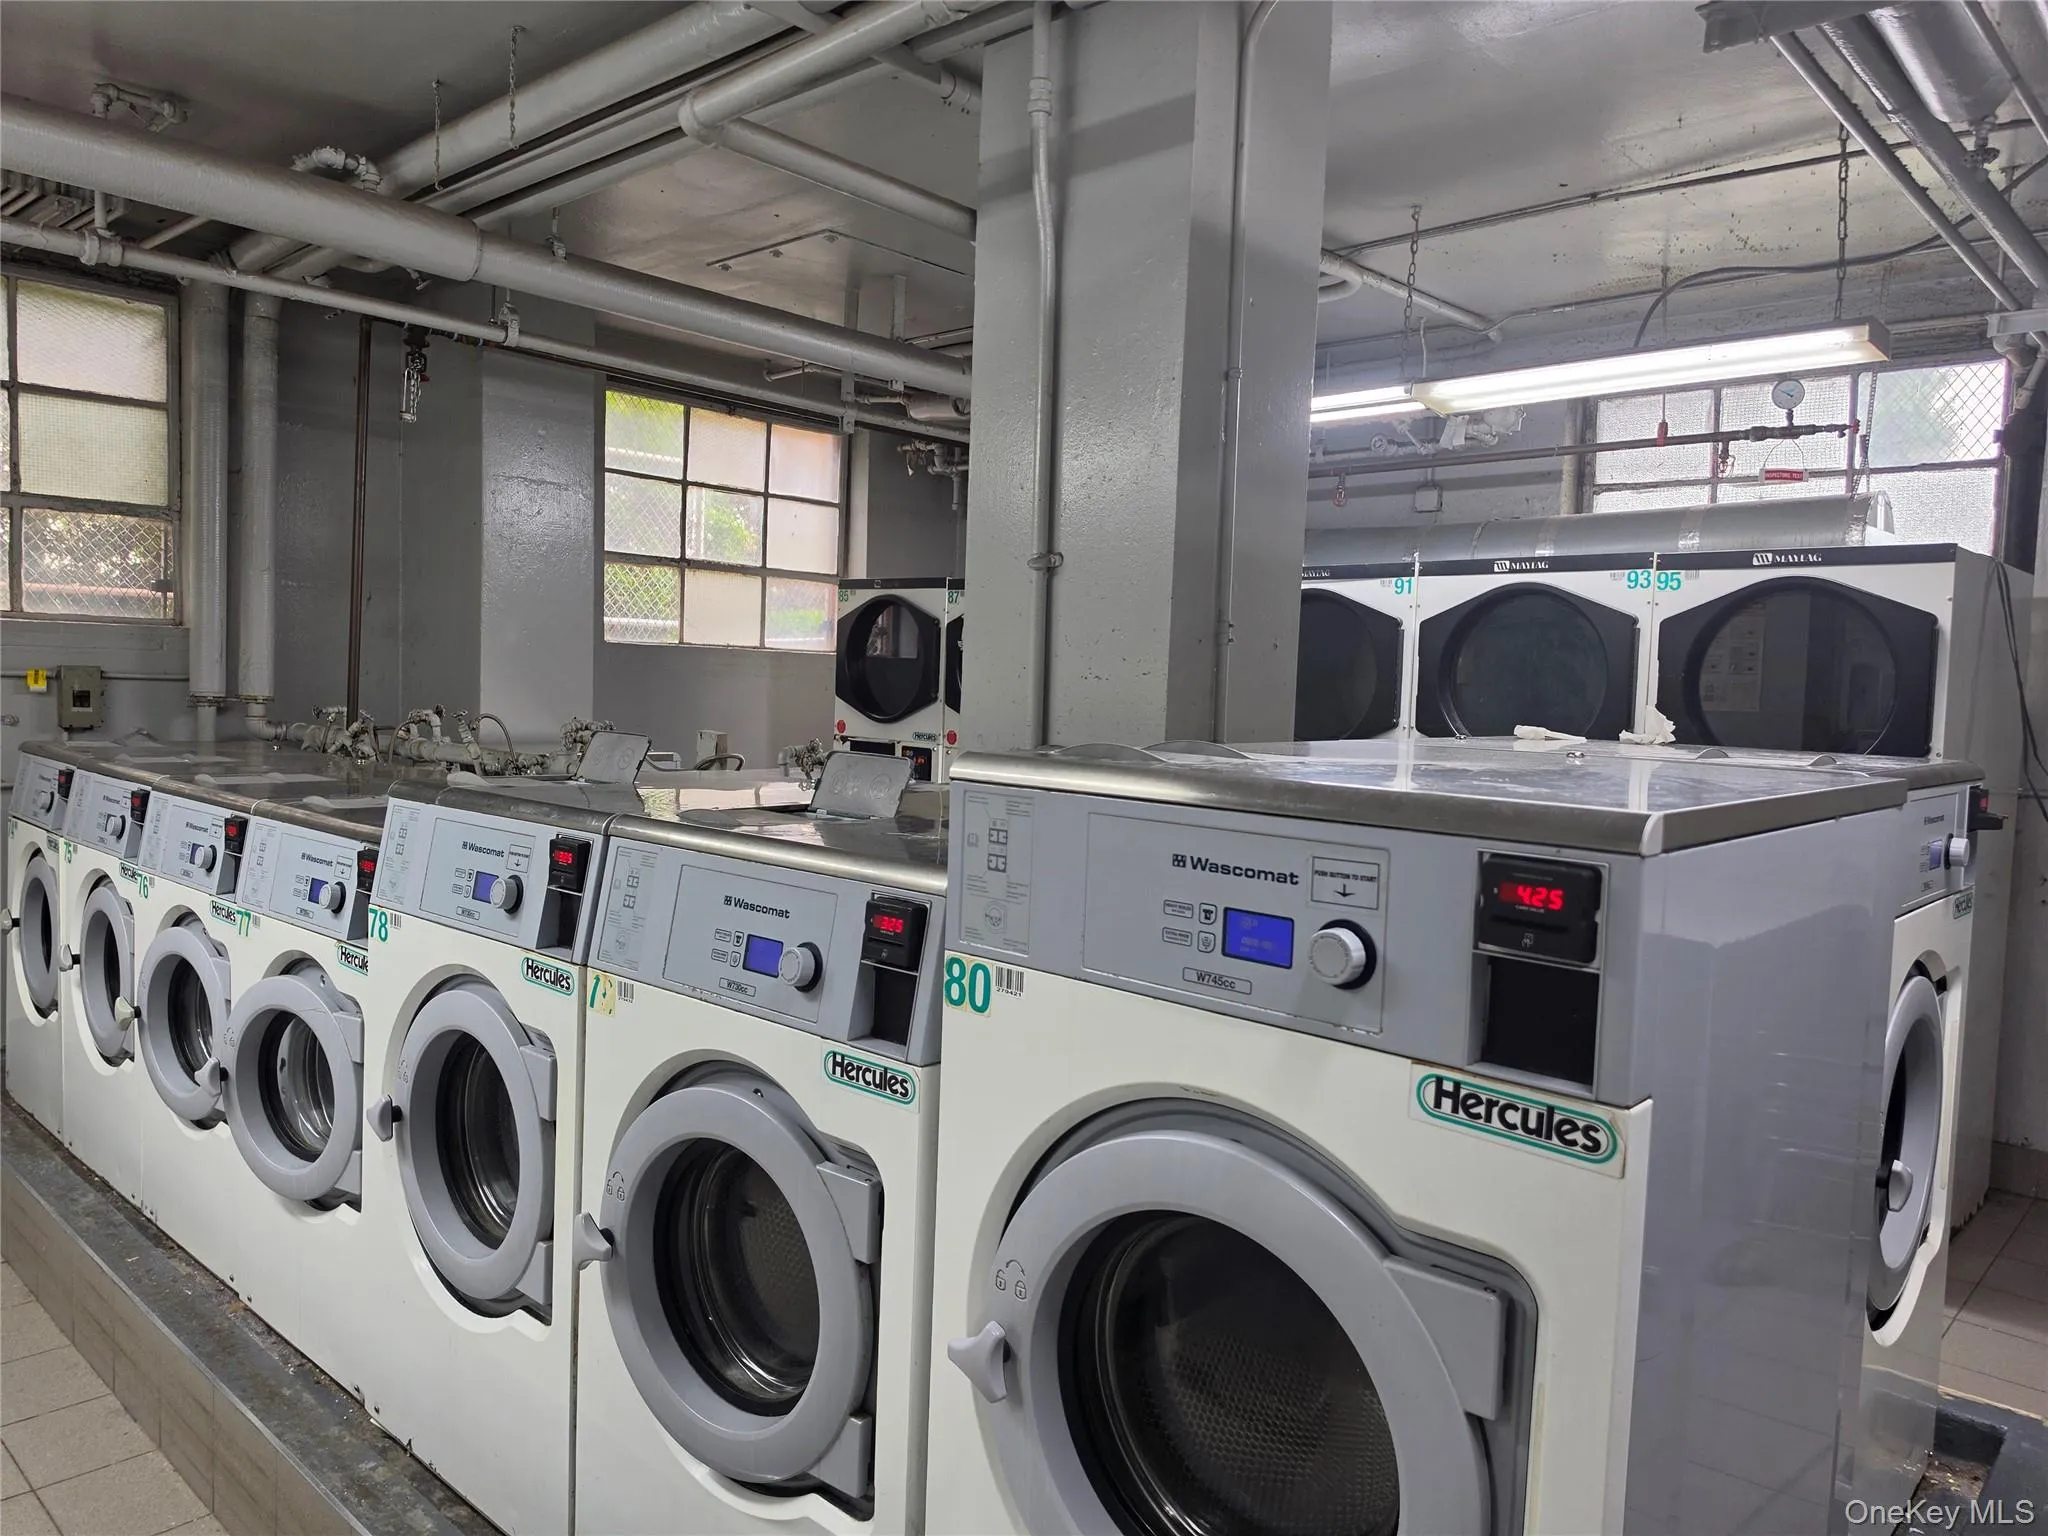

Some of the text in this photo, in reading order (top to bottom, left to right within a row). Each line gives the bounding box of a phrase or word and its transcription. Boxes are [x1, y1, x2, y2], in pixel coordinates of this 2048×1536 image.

[1511, 560, 1549, 570] MAYTAG
[1773, 553, 1822, 563] MAYTAG
[1394, 577, 1413, 595] 91
[1627, 569, 1651, 589] 93
[1657, 571, 1681, 591] 95
[947, 590, 960, 604] 87
[64, 841, 73, 864] 75
[305, 853, 334, 867] Wascomat
[468, 842, 505, 858] Wascomat
[1190, 855, 1300, 886] Wascomat
[136, 874, 149, 899] 76
[211, 900, 237, 923] Hercules
[733, 897, 791, 919] Wascomat
[237, 909, 252, 937] 77
[369, 907, 389, 942] 78
[340, 946, 368, 973] Hercule
[525, 958, 571, 992] Hercules
[945, 956, 991, 1014] 80
[1196, 971, 1236, 990] W745cc
[832, 1051, 909, 1098] Hercules
[1433, 1076, 1601, 1153] Hercules
